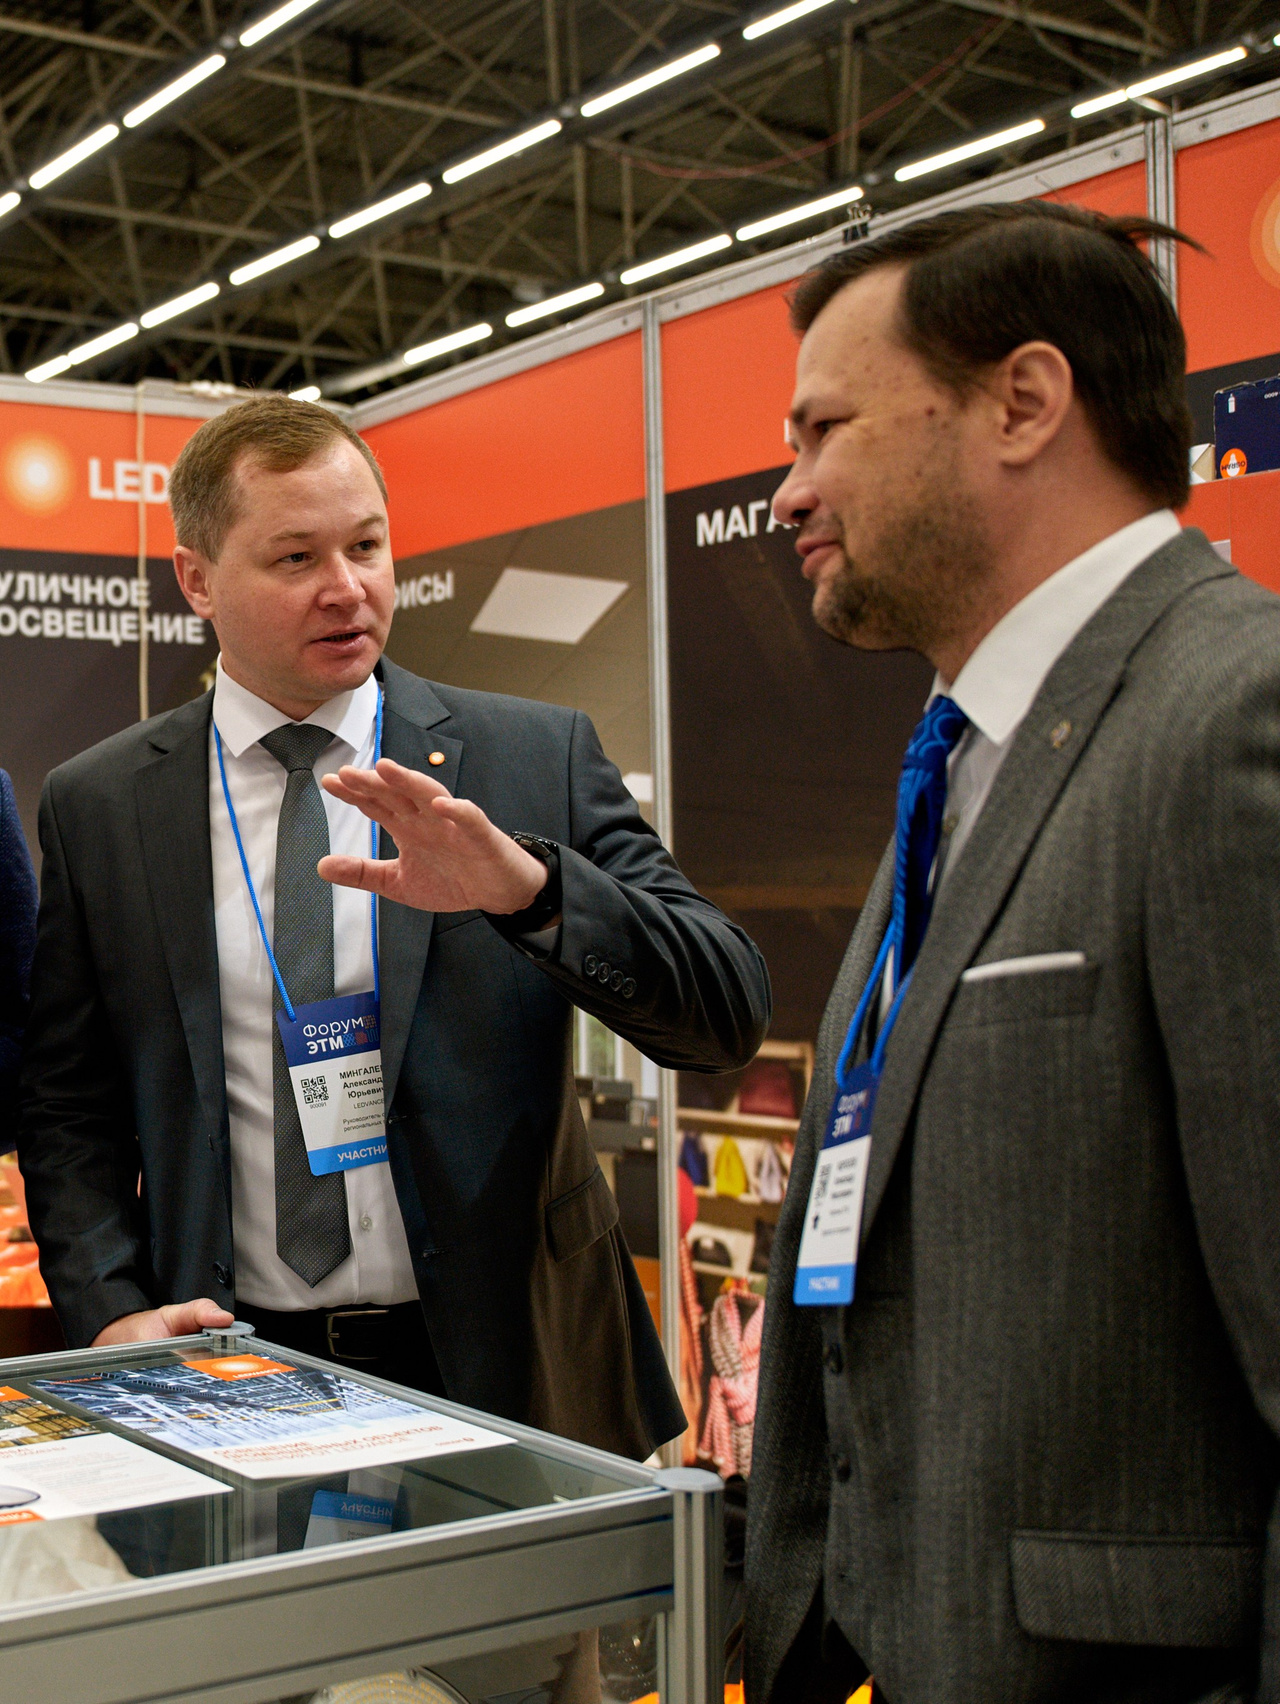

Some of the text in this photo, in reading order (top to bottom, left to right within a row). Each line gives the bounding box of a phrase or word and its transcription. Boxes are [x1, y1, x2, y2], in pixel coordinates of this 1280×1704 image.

[88, 457, 171, 504] LED
[302, 1016, 365, 1037] Форум
[306, 1034, 345, 1055] ЭТМ
